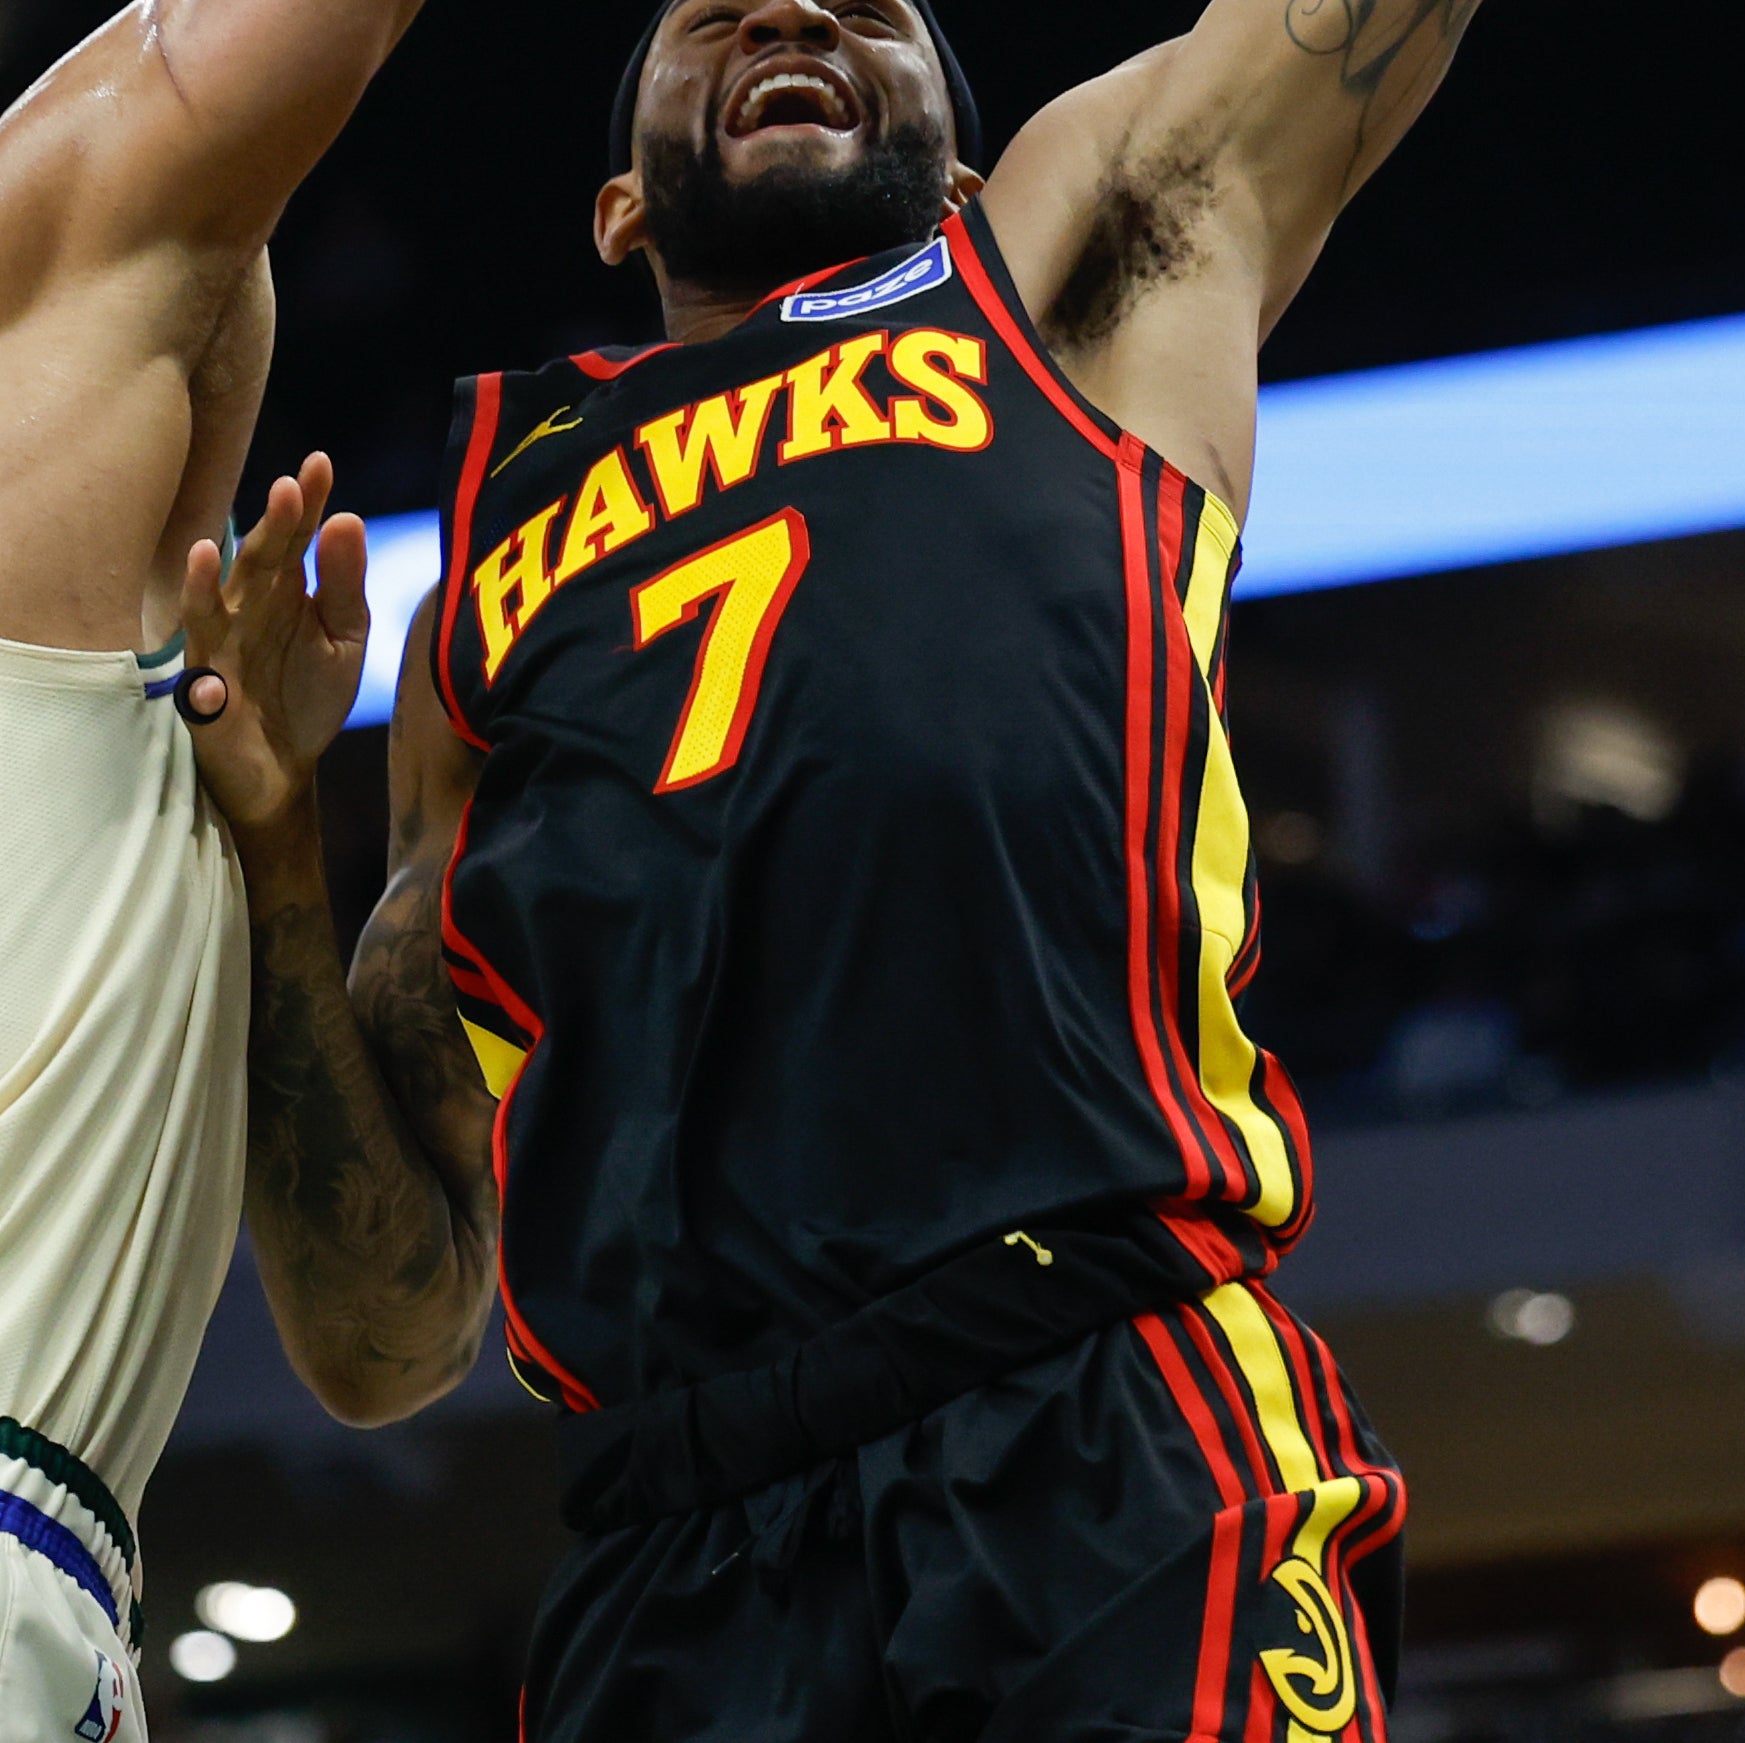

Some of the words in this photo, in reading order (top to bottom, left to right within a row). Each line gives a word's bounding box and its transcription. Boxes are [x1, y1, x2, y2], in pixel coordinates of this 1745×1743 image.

[799, 258, 934, 315] paze
[469, 327, 994, 690] HAWKS
[629, 506, 811, 795] 7
